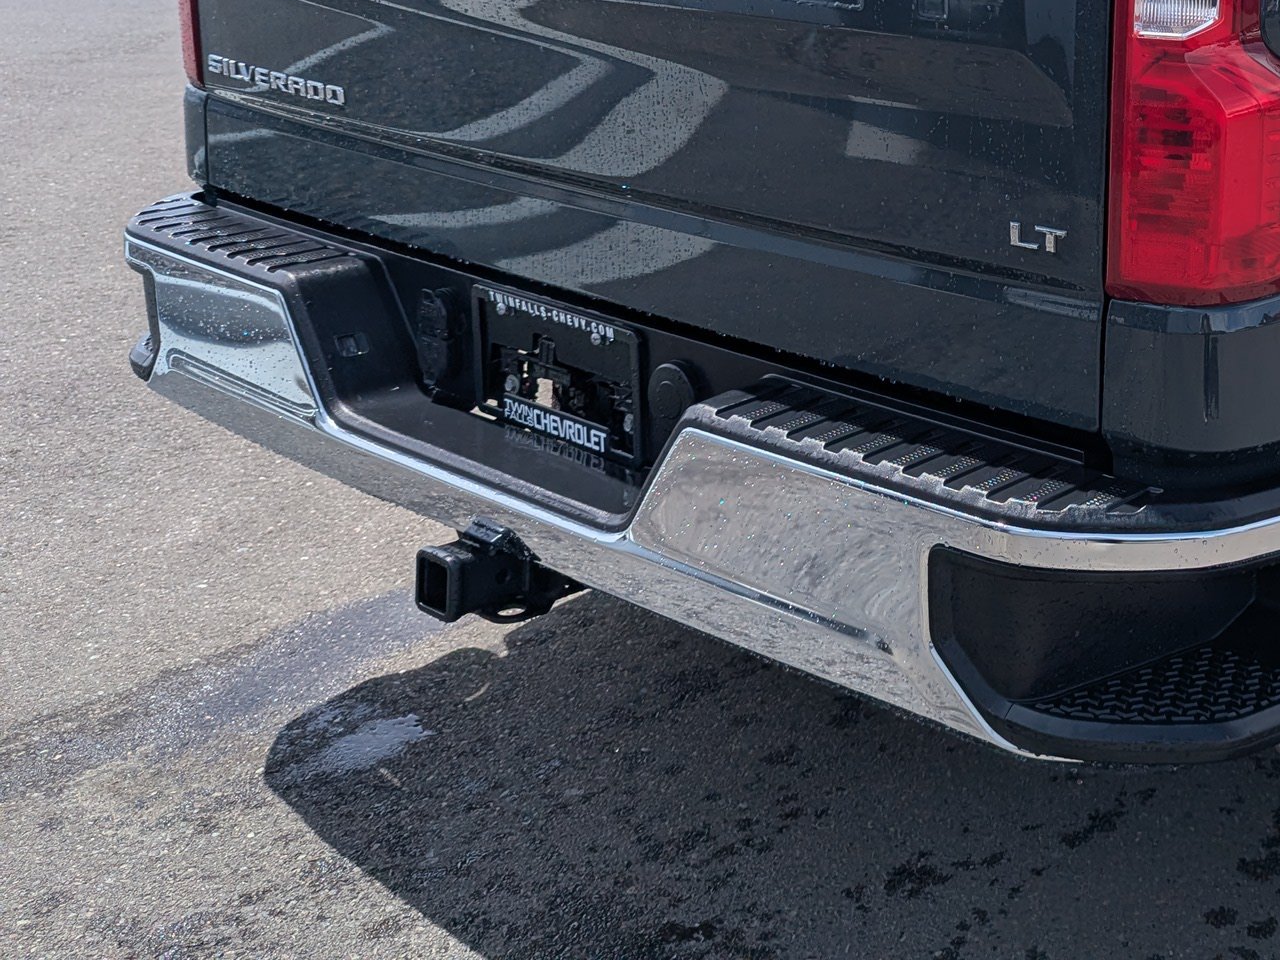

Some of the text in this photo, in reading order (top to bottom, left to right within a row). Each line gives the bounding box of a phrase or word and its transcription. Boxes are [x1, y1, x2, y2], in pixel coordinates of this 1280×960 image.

[207, 54, 346, 106] SILVERADO
[1010, 221, 1068, 253] LT
[489, 291, 614, 339] TWINFALLS-CHEVY.COM
[504, 398, 534, 417] TWIN
[504, 408, 535, 427] FALLS
[533, 409, 607, 453] CHEVROLET
